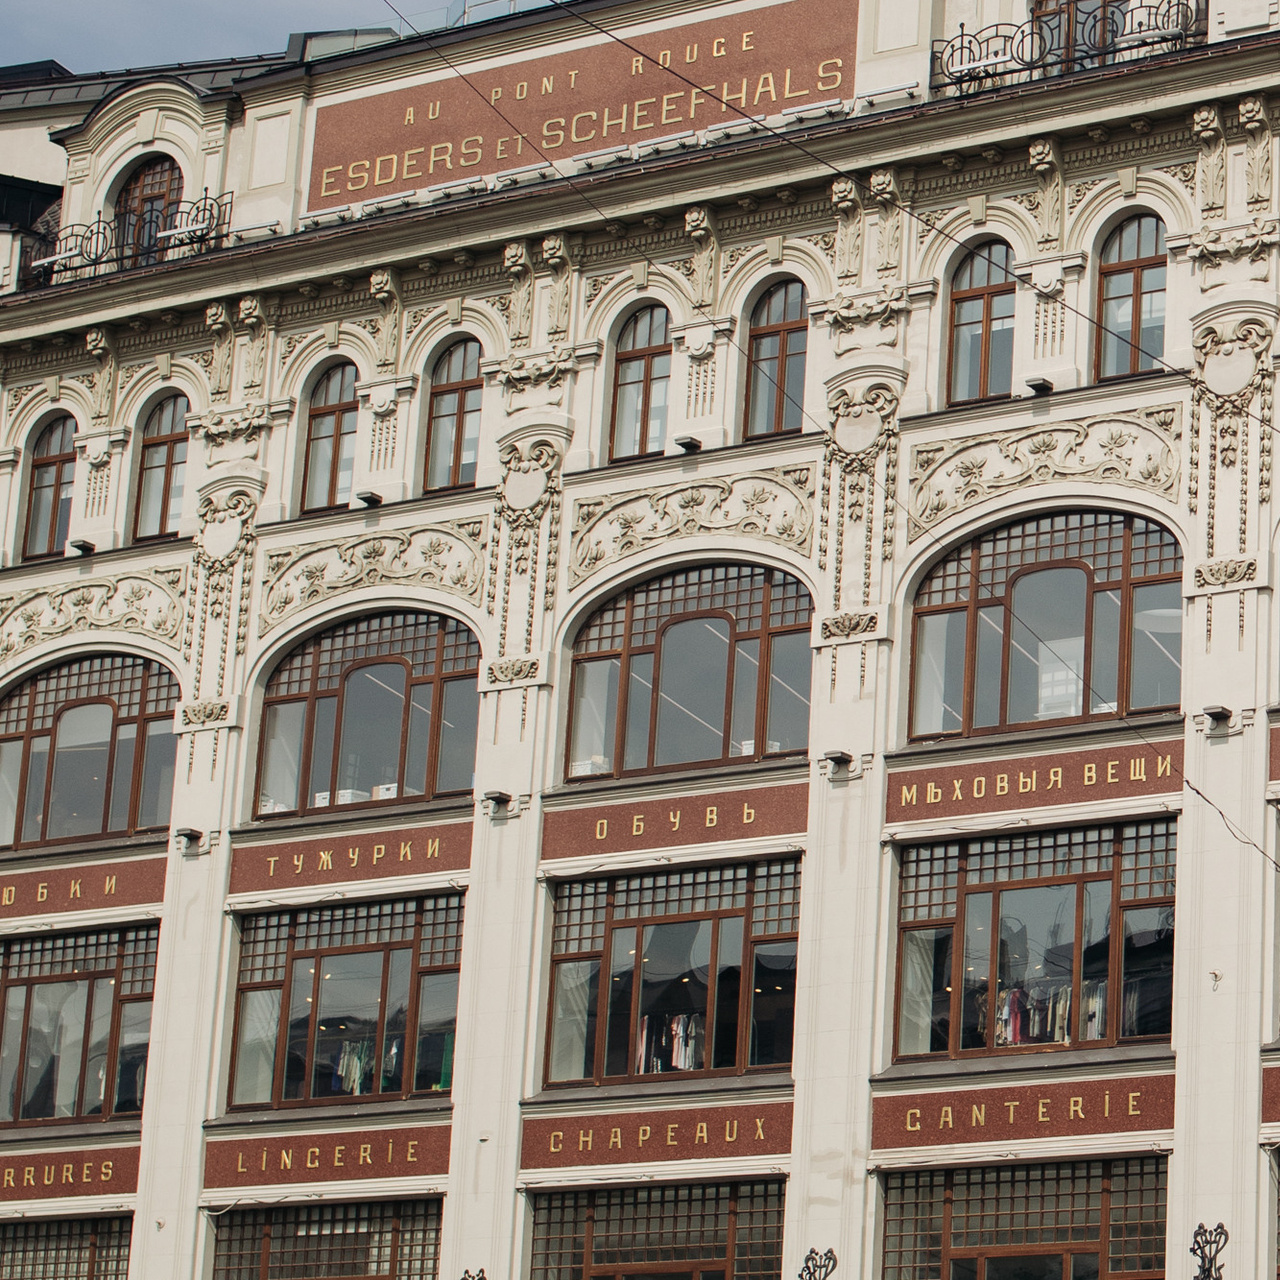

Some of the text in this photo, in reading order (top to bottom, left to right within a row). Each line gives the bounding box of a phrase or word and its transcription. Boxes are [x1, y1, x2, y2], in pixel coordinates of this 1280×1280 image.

[404, 31, 755, 126] AU PONT ROUGE
[320, 58, 844, 198] ESDERS ET SCHEEFHALS
[1083, 754, 1171, 786] ВЕЩИ
[595, 803, 755, 840] ОБУВЬ
[266, 838, 441, 877] ТУЖУРКИ
[2, 875, 117, 906] ЮБКИ
[549, 1118, 765, 1153] CHAPEAUX
